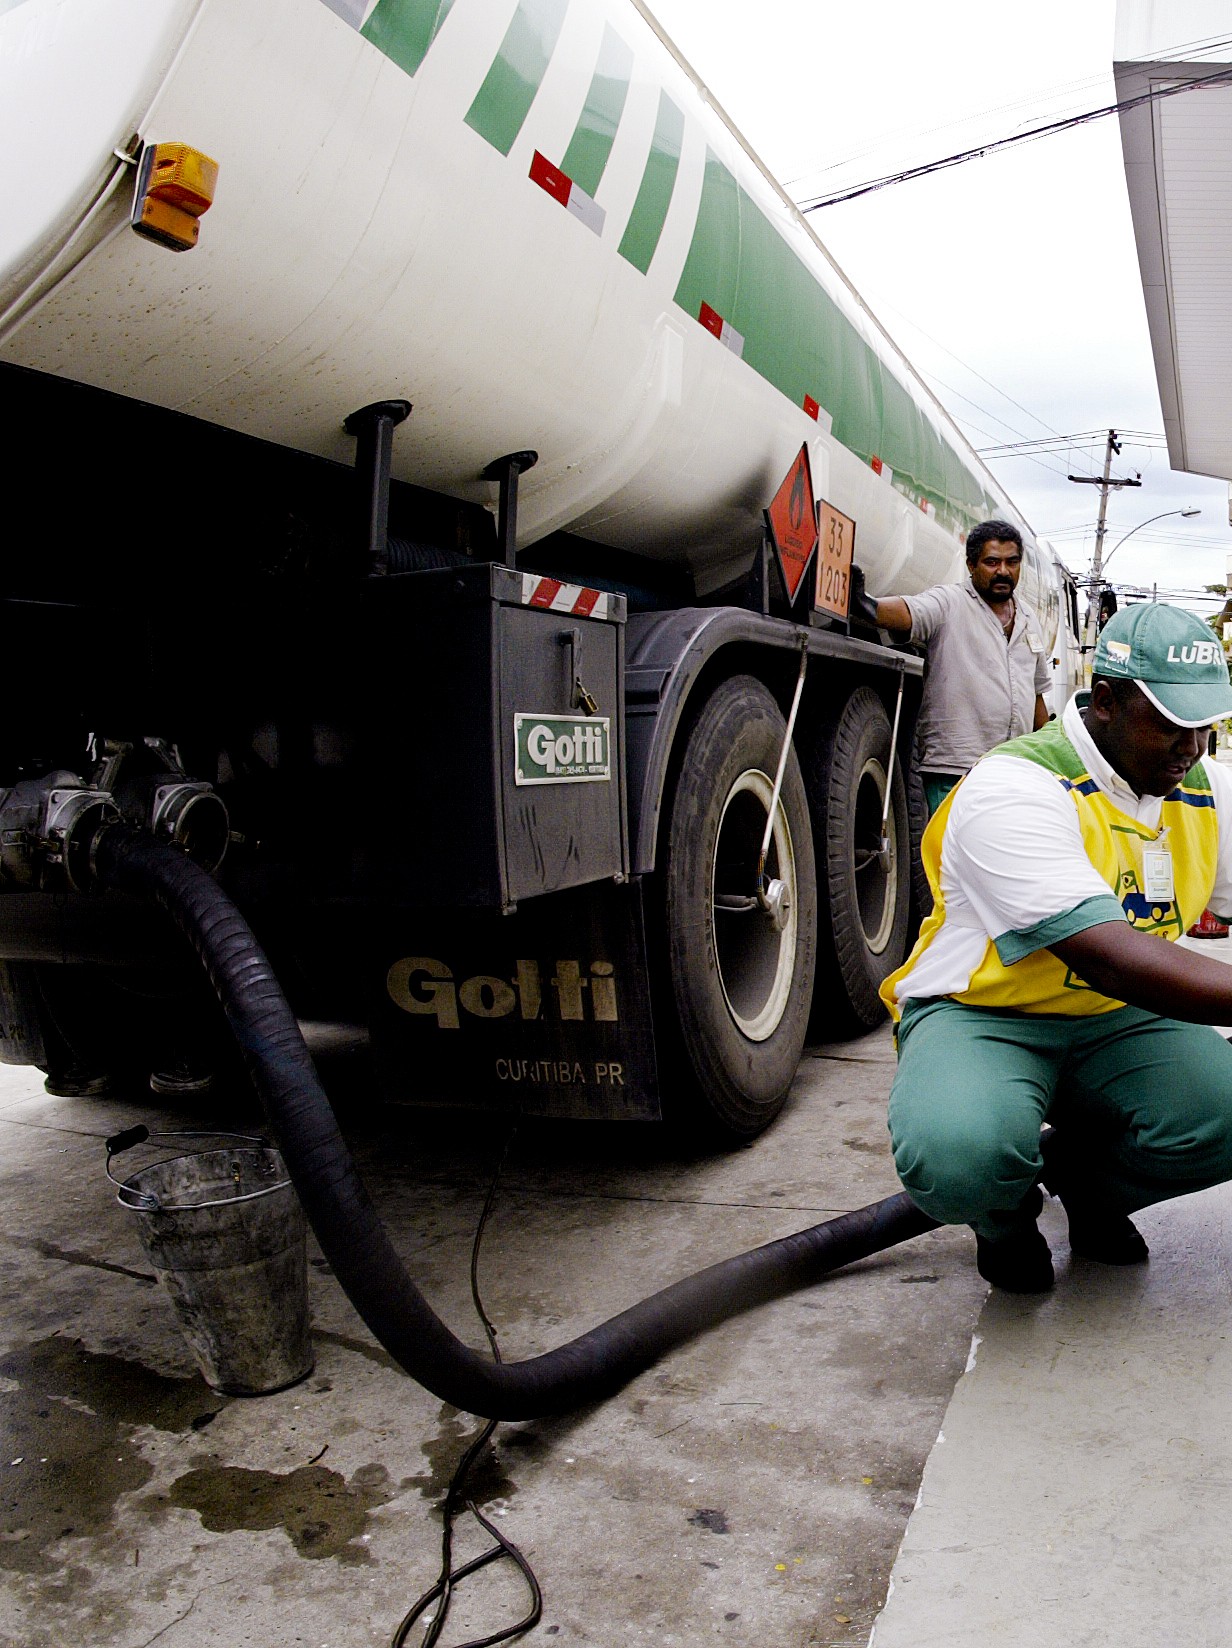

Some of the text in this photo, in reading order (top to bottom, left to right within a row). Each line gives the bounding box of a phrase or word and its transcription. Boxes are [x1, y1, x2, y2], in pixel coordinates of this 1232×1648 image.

[829, 517, 844, 557] 33
[819, 561, 848, 608] 1203
[527, 724, 603, 774] Gotti
[595, 1063, 625, 1086] PR
